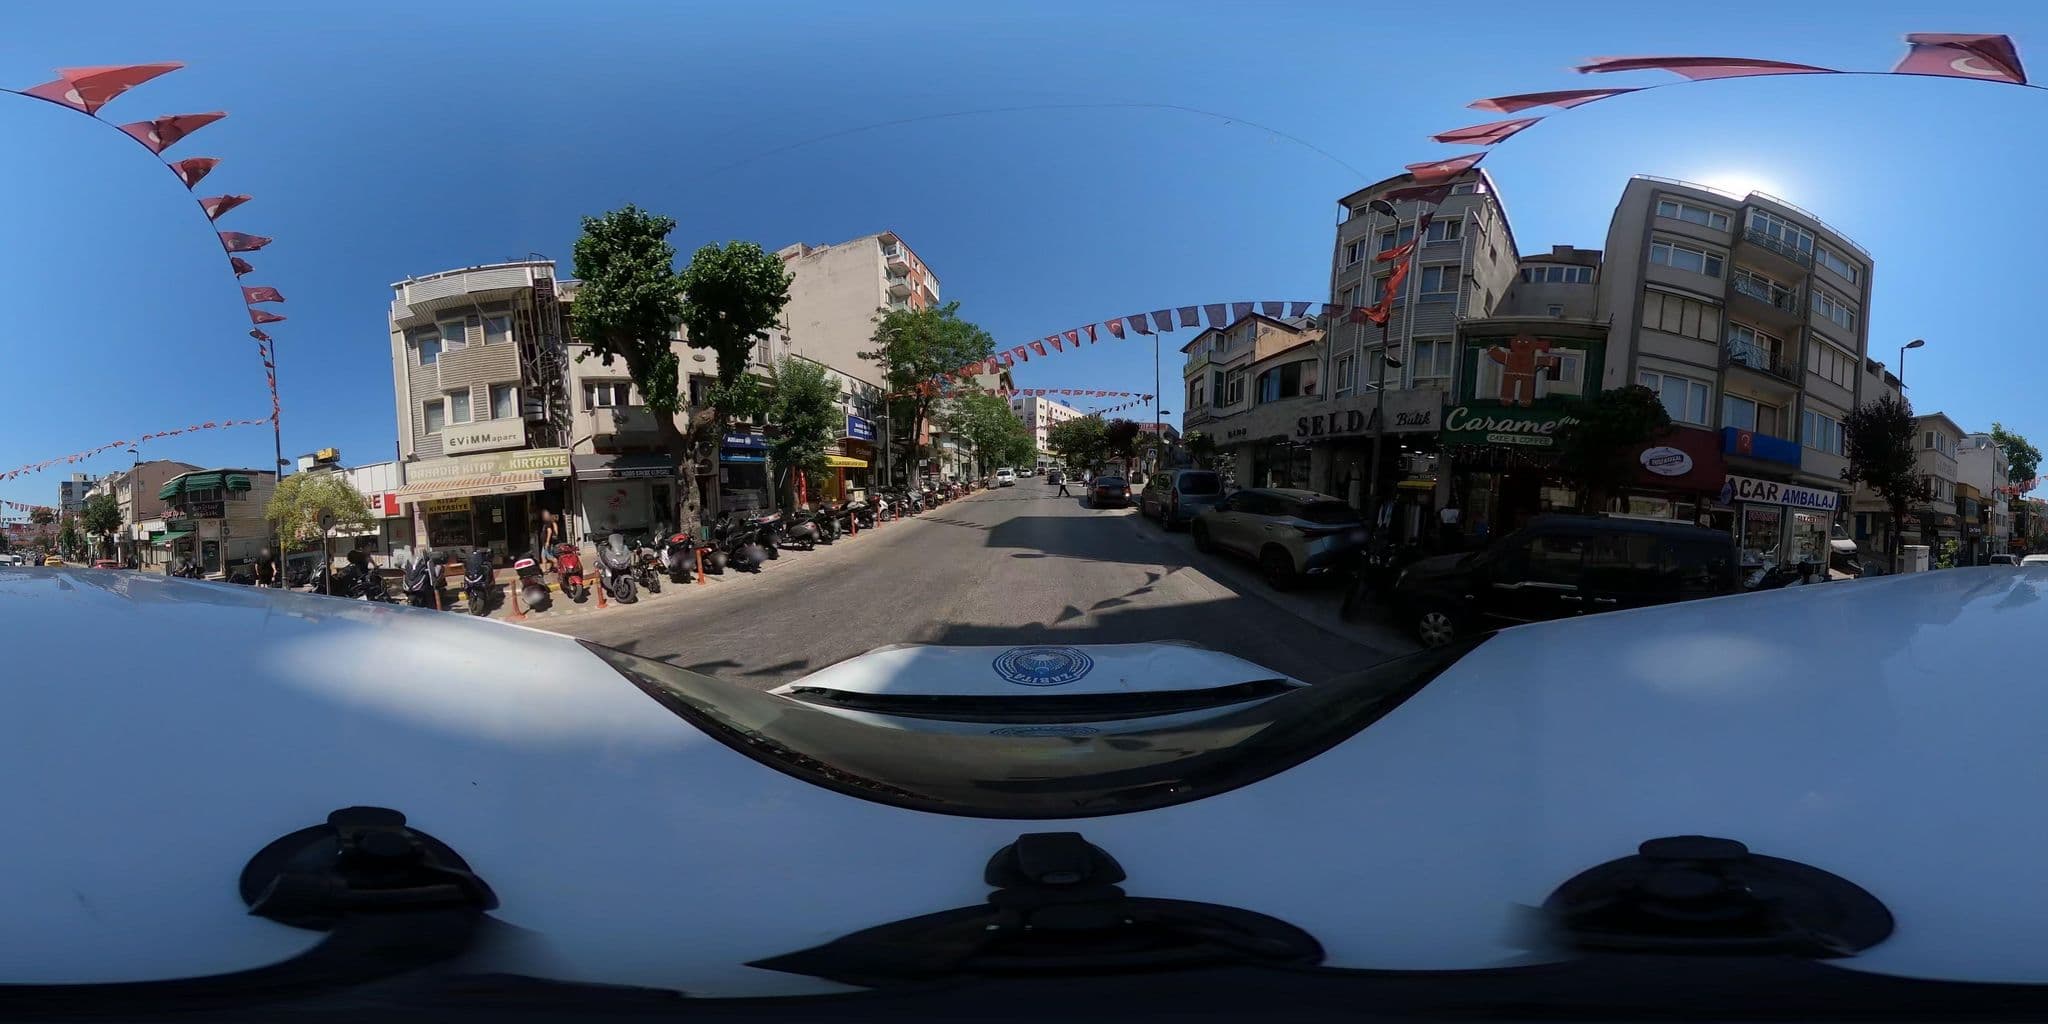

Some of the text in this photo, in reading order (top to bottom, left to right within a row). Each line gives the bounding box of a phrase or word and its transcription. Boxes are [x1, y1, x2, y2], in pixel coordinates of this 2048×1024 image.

[1395, 411, 1431, 426] Butik
[1728, 477, 1835, 509] ACAR AMBALAJ
